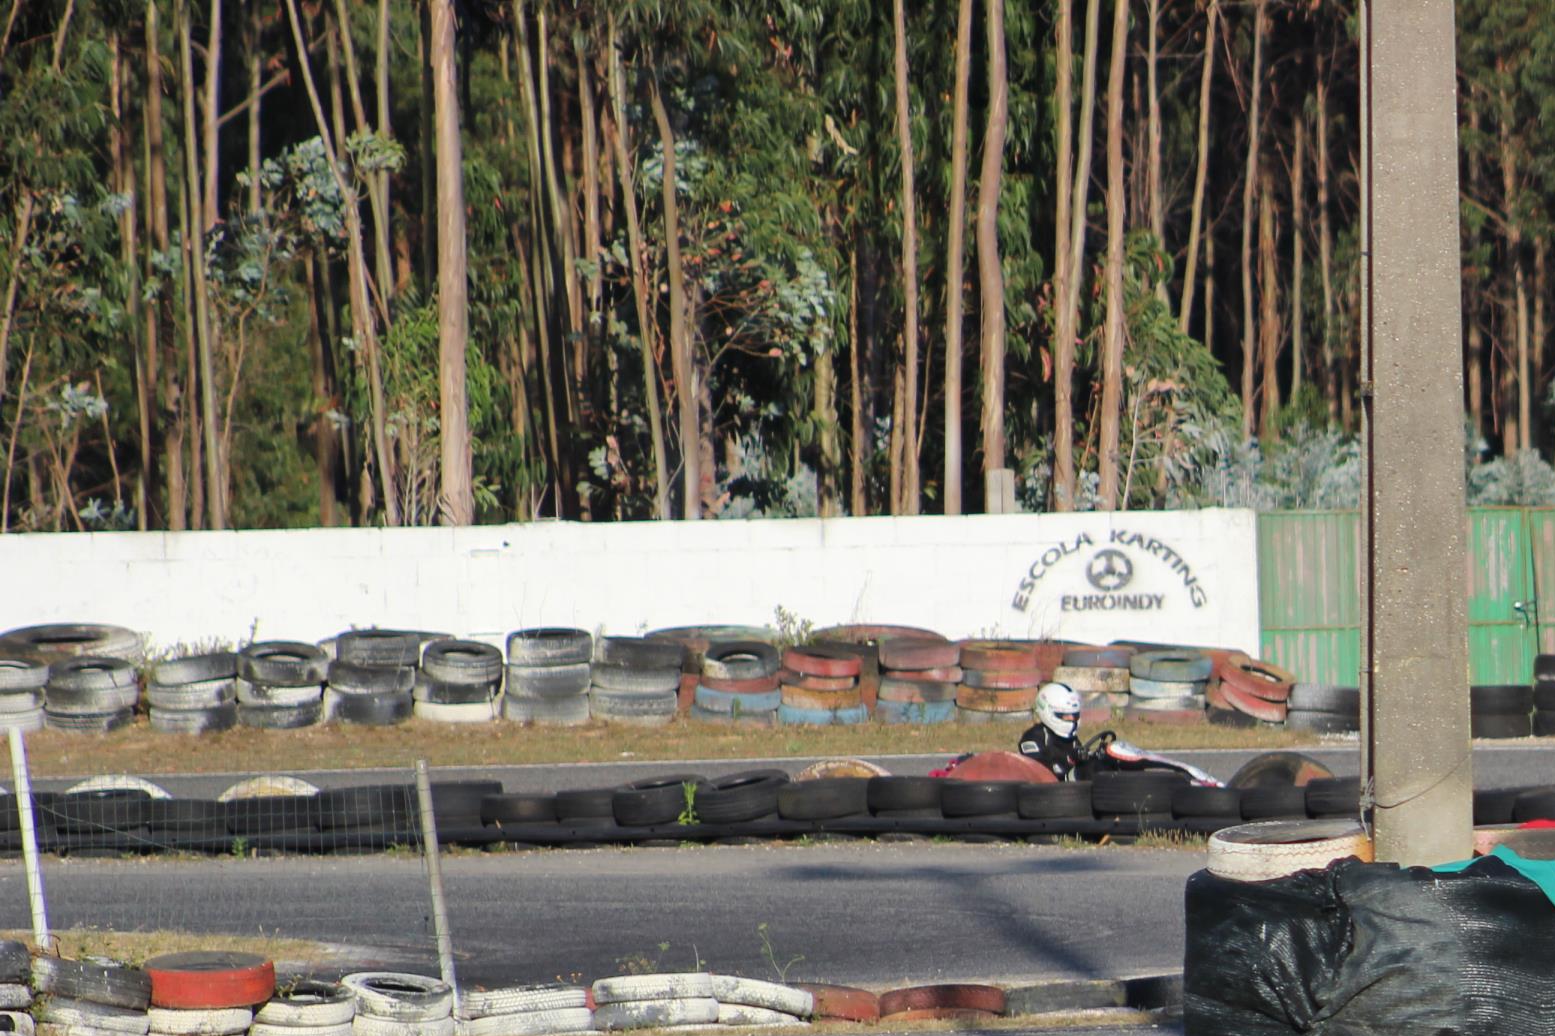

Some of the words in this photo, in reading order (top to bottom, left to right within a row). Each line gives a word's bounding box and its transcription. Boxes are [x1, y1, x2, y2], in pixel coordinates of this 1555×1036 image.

[1012, 532, 1094, 613] ESCOLA
[1110, 530, 1208, 608] KARTING
[1060, 594, 1165, 612] EUROINDY
